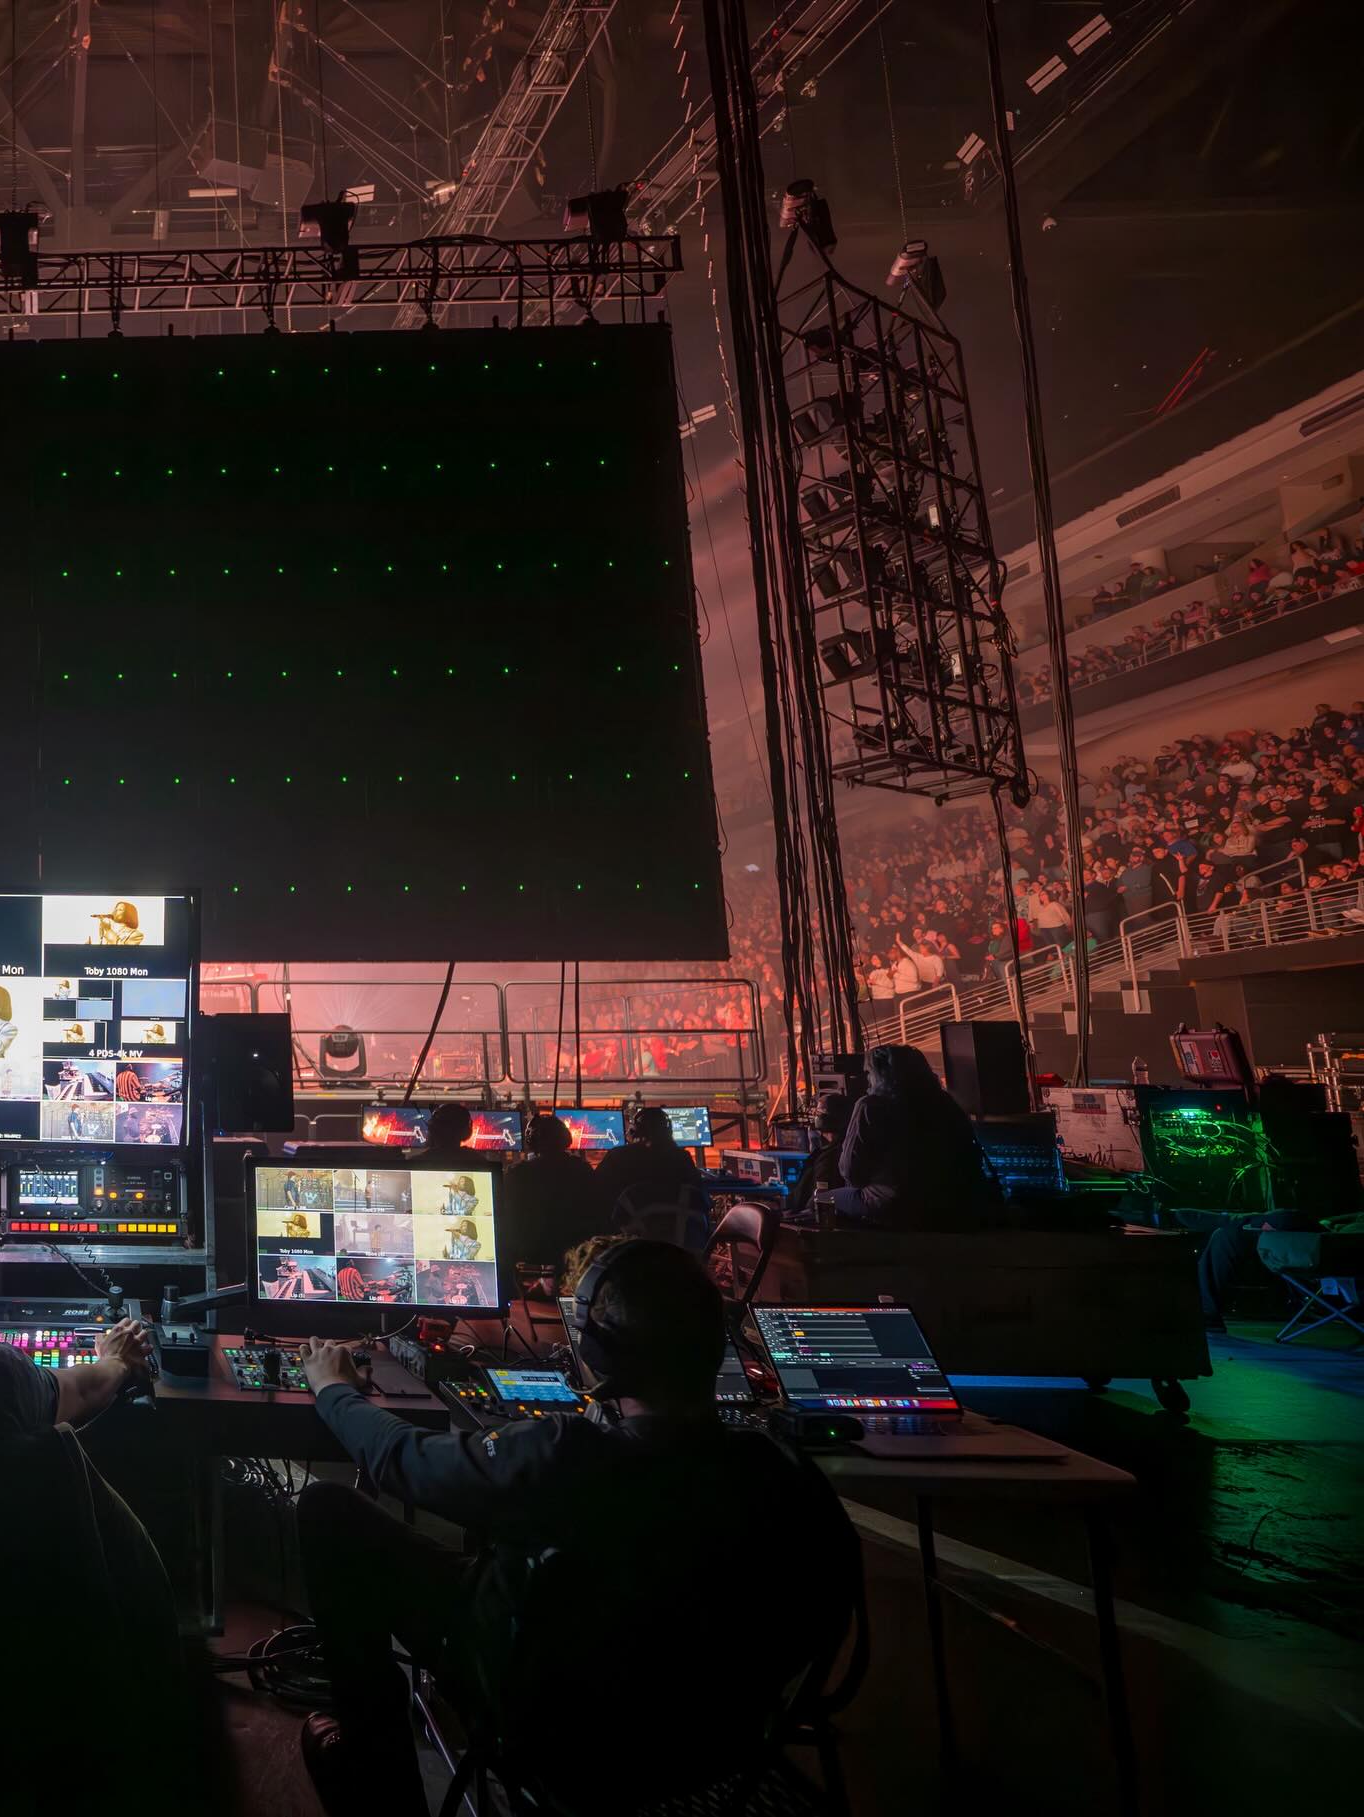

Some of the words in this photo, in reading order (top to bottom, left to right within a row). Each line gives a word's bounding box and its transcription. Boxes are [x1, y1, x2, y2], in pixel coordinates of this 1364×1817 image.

[2, 965, 25, 975] Mon
[84, 966, 104, 976] Toby
[106, 967, 128, 976] 1080
[130, 967, 148, 976] Mon
[88, 1049, 95, 1057] 4
[129, 1050, 143, 1058] MV
